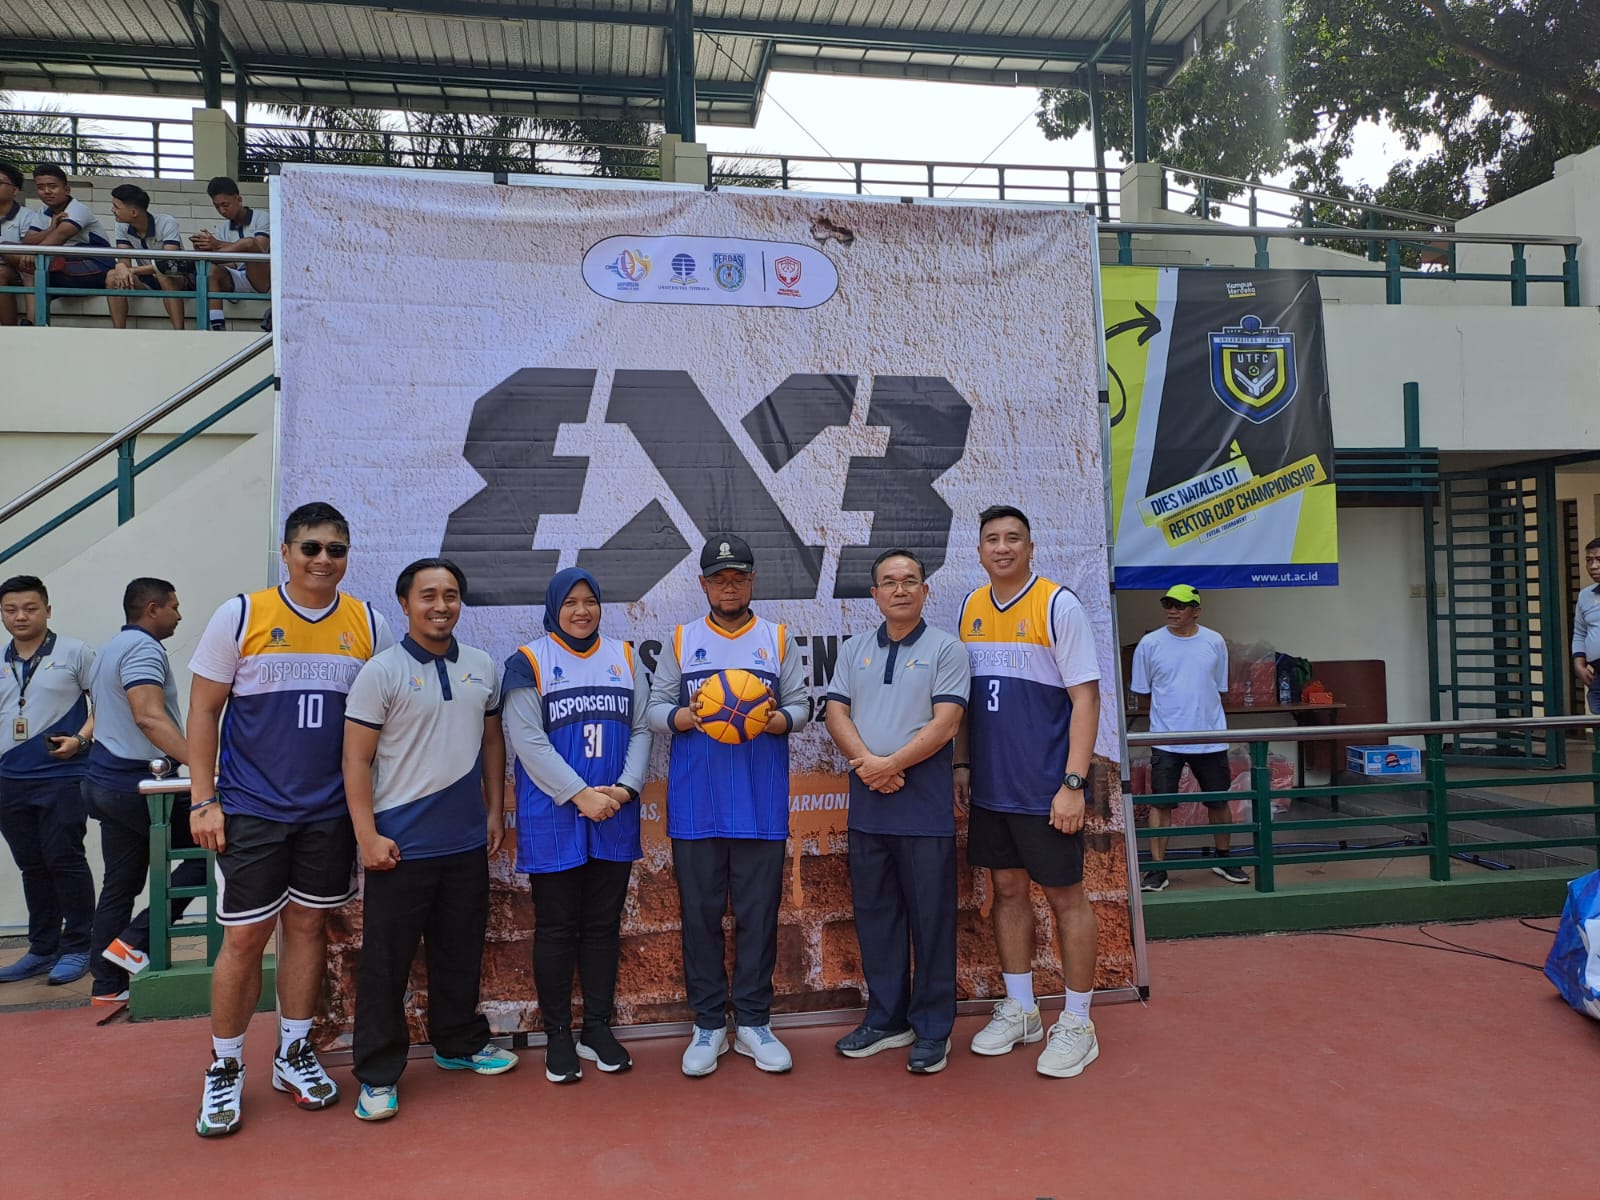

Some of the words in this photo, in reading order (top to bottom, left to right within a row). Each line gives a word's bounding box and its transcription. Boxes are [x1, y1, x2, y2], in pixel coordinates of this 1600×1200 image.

[1237, 354, 1269, 363] UTFC
[1151, 493, 1179, 516] DIES
[1177, 474, 1224, 506] NATALIS
[1222, 467, 1239, 486] UT
[1168, 508, 1215, 540] REKTOR
[1213, 498, 1235, 522] CUP
[1235, 463, 1316, 511] CHAMPIONSHIP
[1251, 572, 1318, 583] www.ut.ac.id
[259, 661, 341, 685] DISPORSENI
[297, 694, 324, 728] 10
[549, 691, 617, 723] DISPORSENI
[618, 696, 630, 717] UT
[987, 679, 1001, 712] 3
[583, 723, 603, 758] 31
